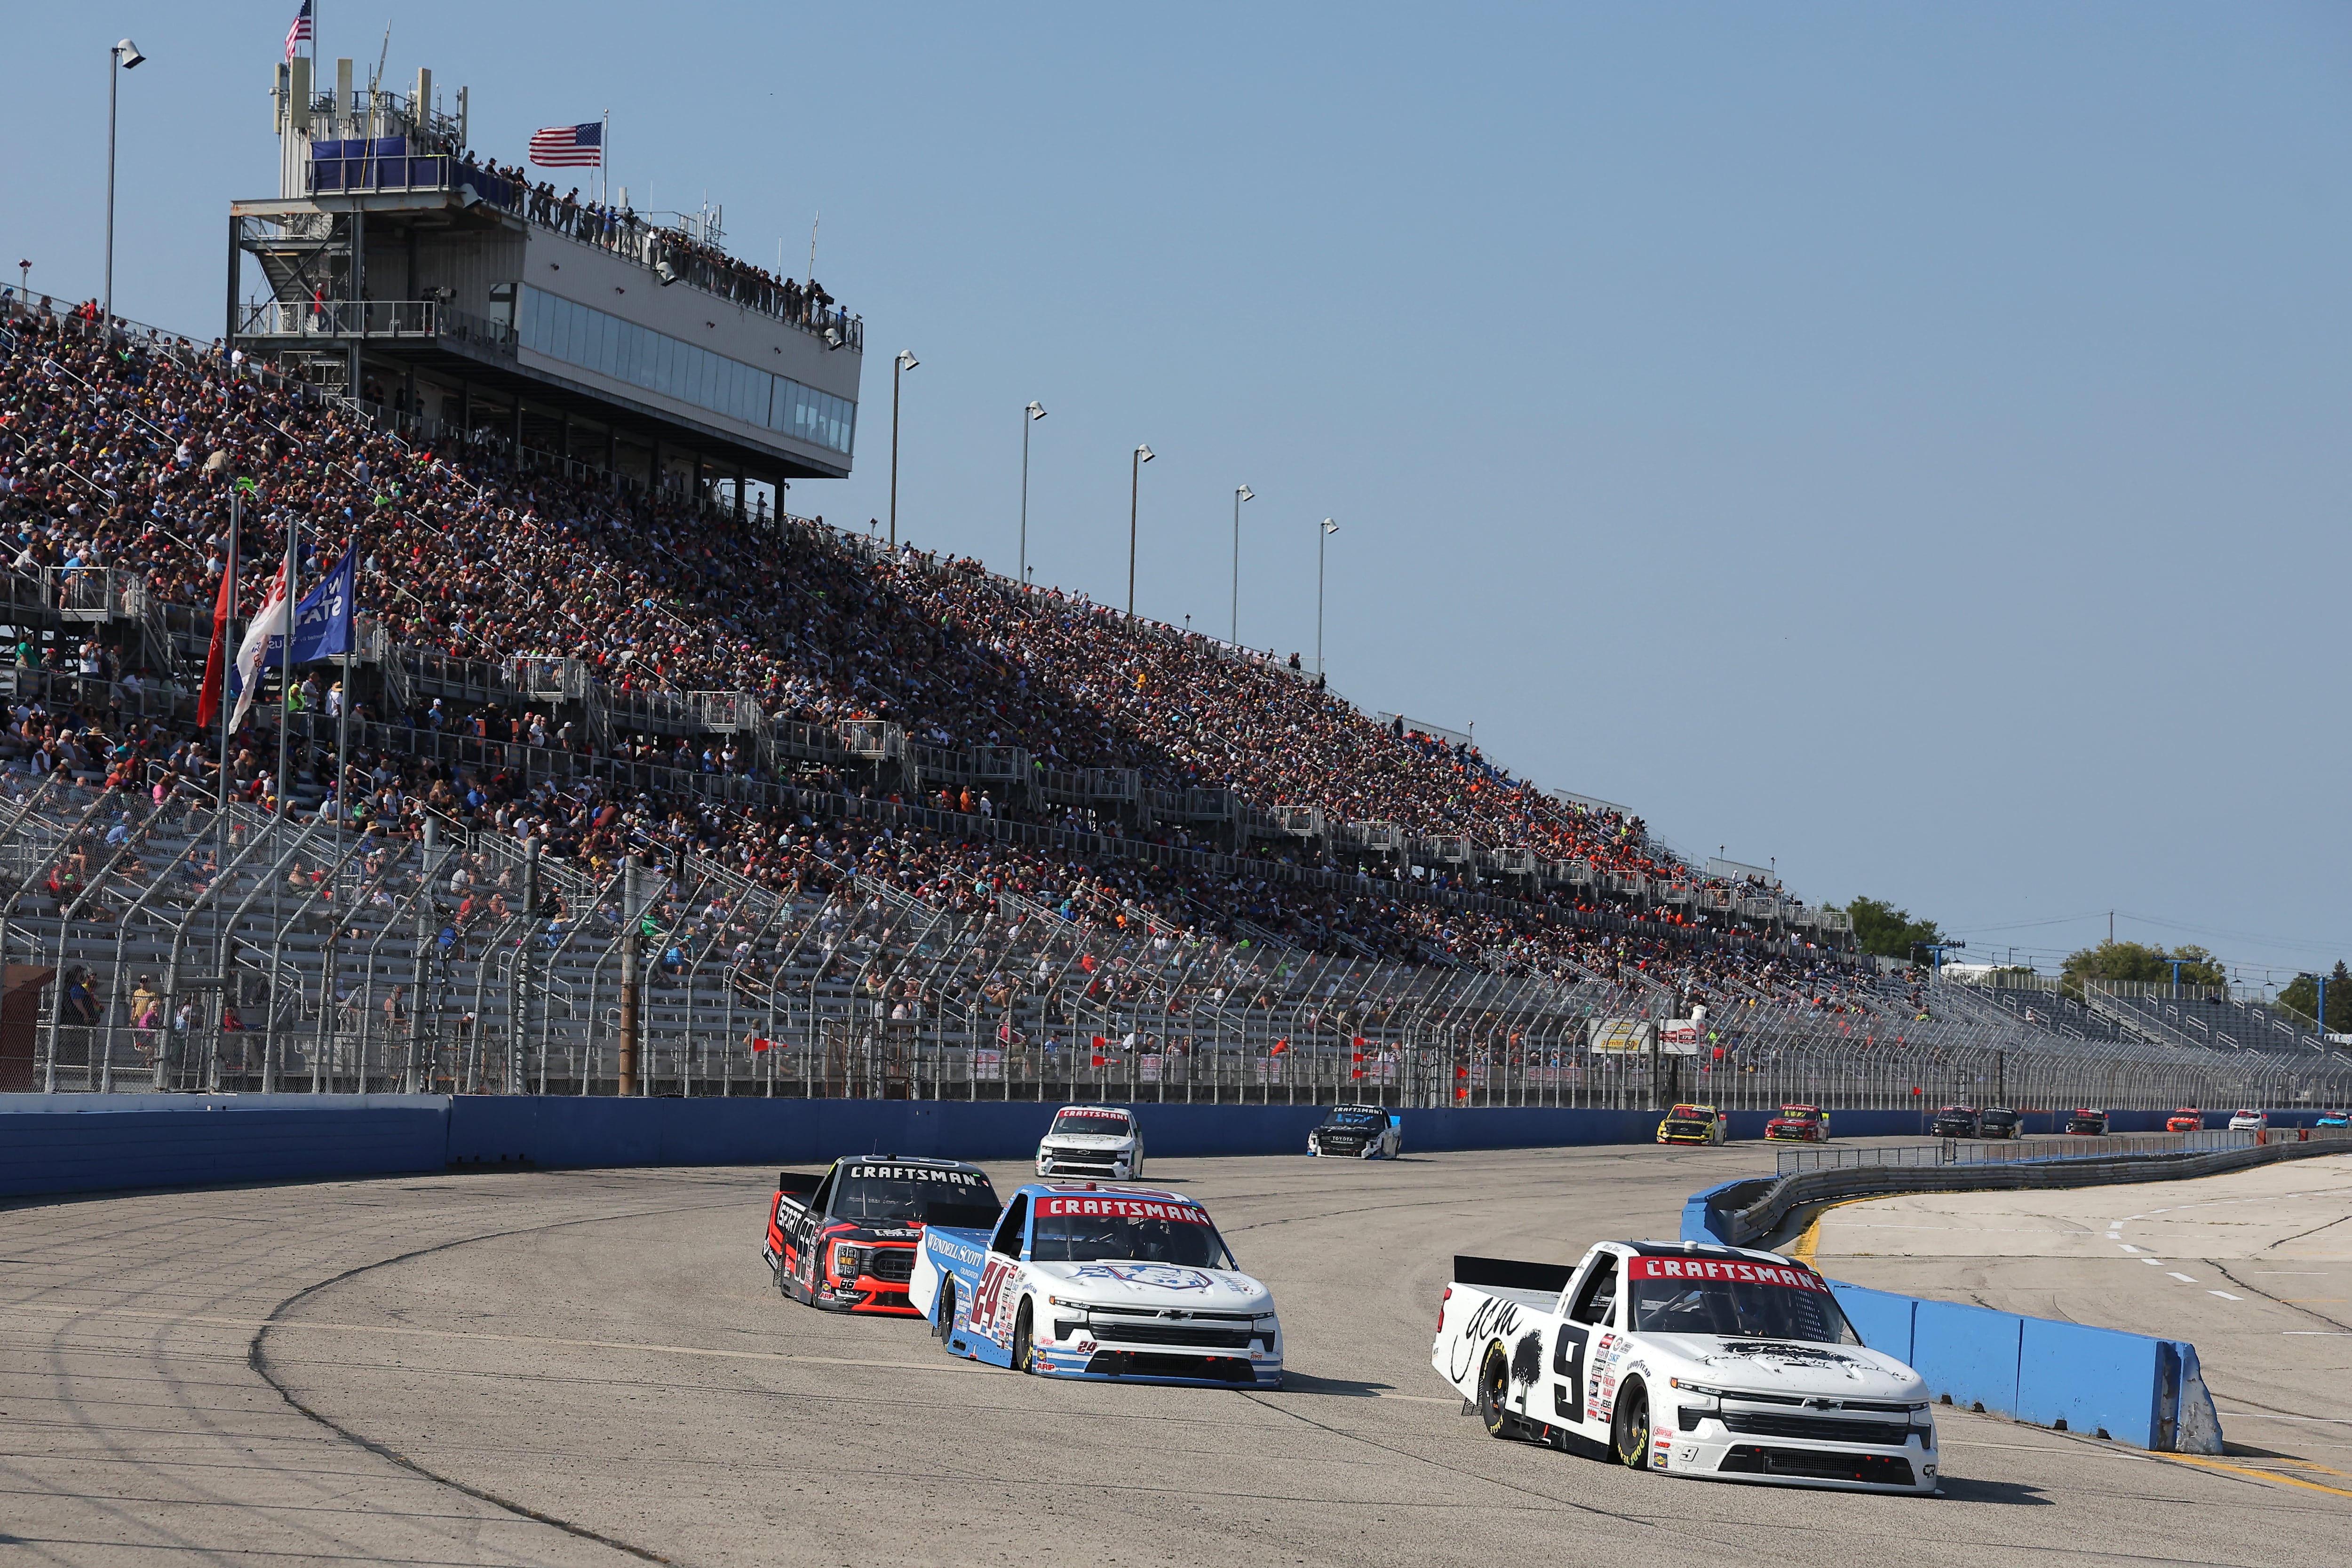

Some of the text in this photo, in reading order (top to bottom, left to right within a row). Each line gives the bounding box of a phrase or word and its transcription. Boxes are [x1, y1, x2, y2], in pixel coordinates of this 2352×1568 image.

[1063, 1111, 1125, 1120] CRAFTSMAN
[850, 1166, 977, 1186] CRAFTSMAN
[1050, 1200, 1199, 1223] CRAFTSMAN
[927, 1233, 983, 1267] WENDELL SCOTT
[959, 1266, 979, 1280] FOUNDATION
[1646, 1260, 1817, 1290] CRAFTSMAN
[970, 1259, 1010, 1331] 24
[1077, 1341, 1098, 1353] 24
[1608, 1353, 1621, 1363] SKF
[1553, 1323, 1589, 1424] 9
[1627, 1359, 1651, 1378] GOODYEAR
[1490, 1415, 1504, 1434] EAGLE
[1617, 1428, 1647, 1466] GOODYEAR
[1679, 1446, 1699, 1462] 9
